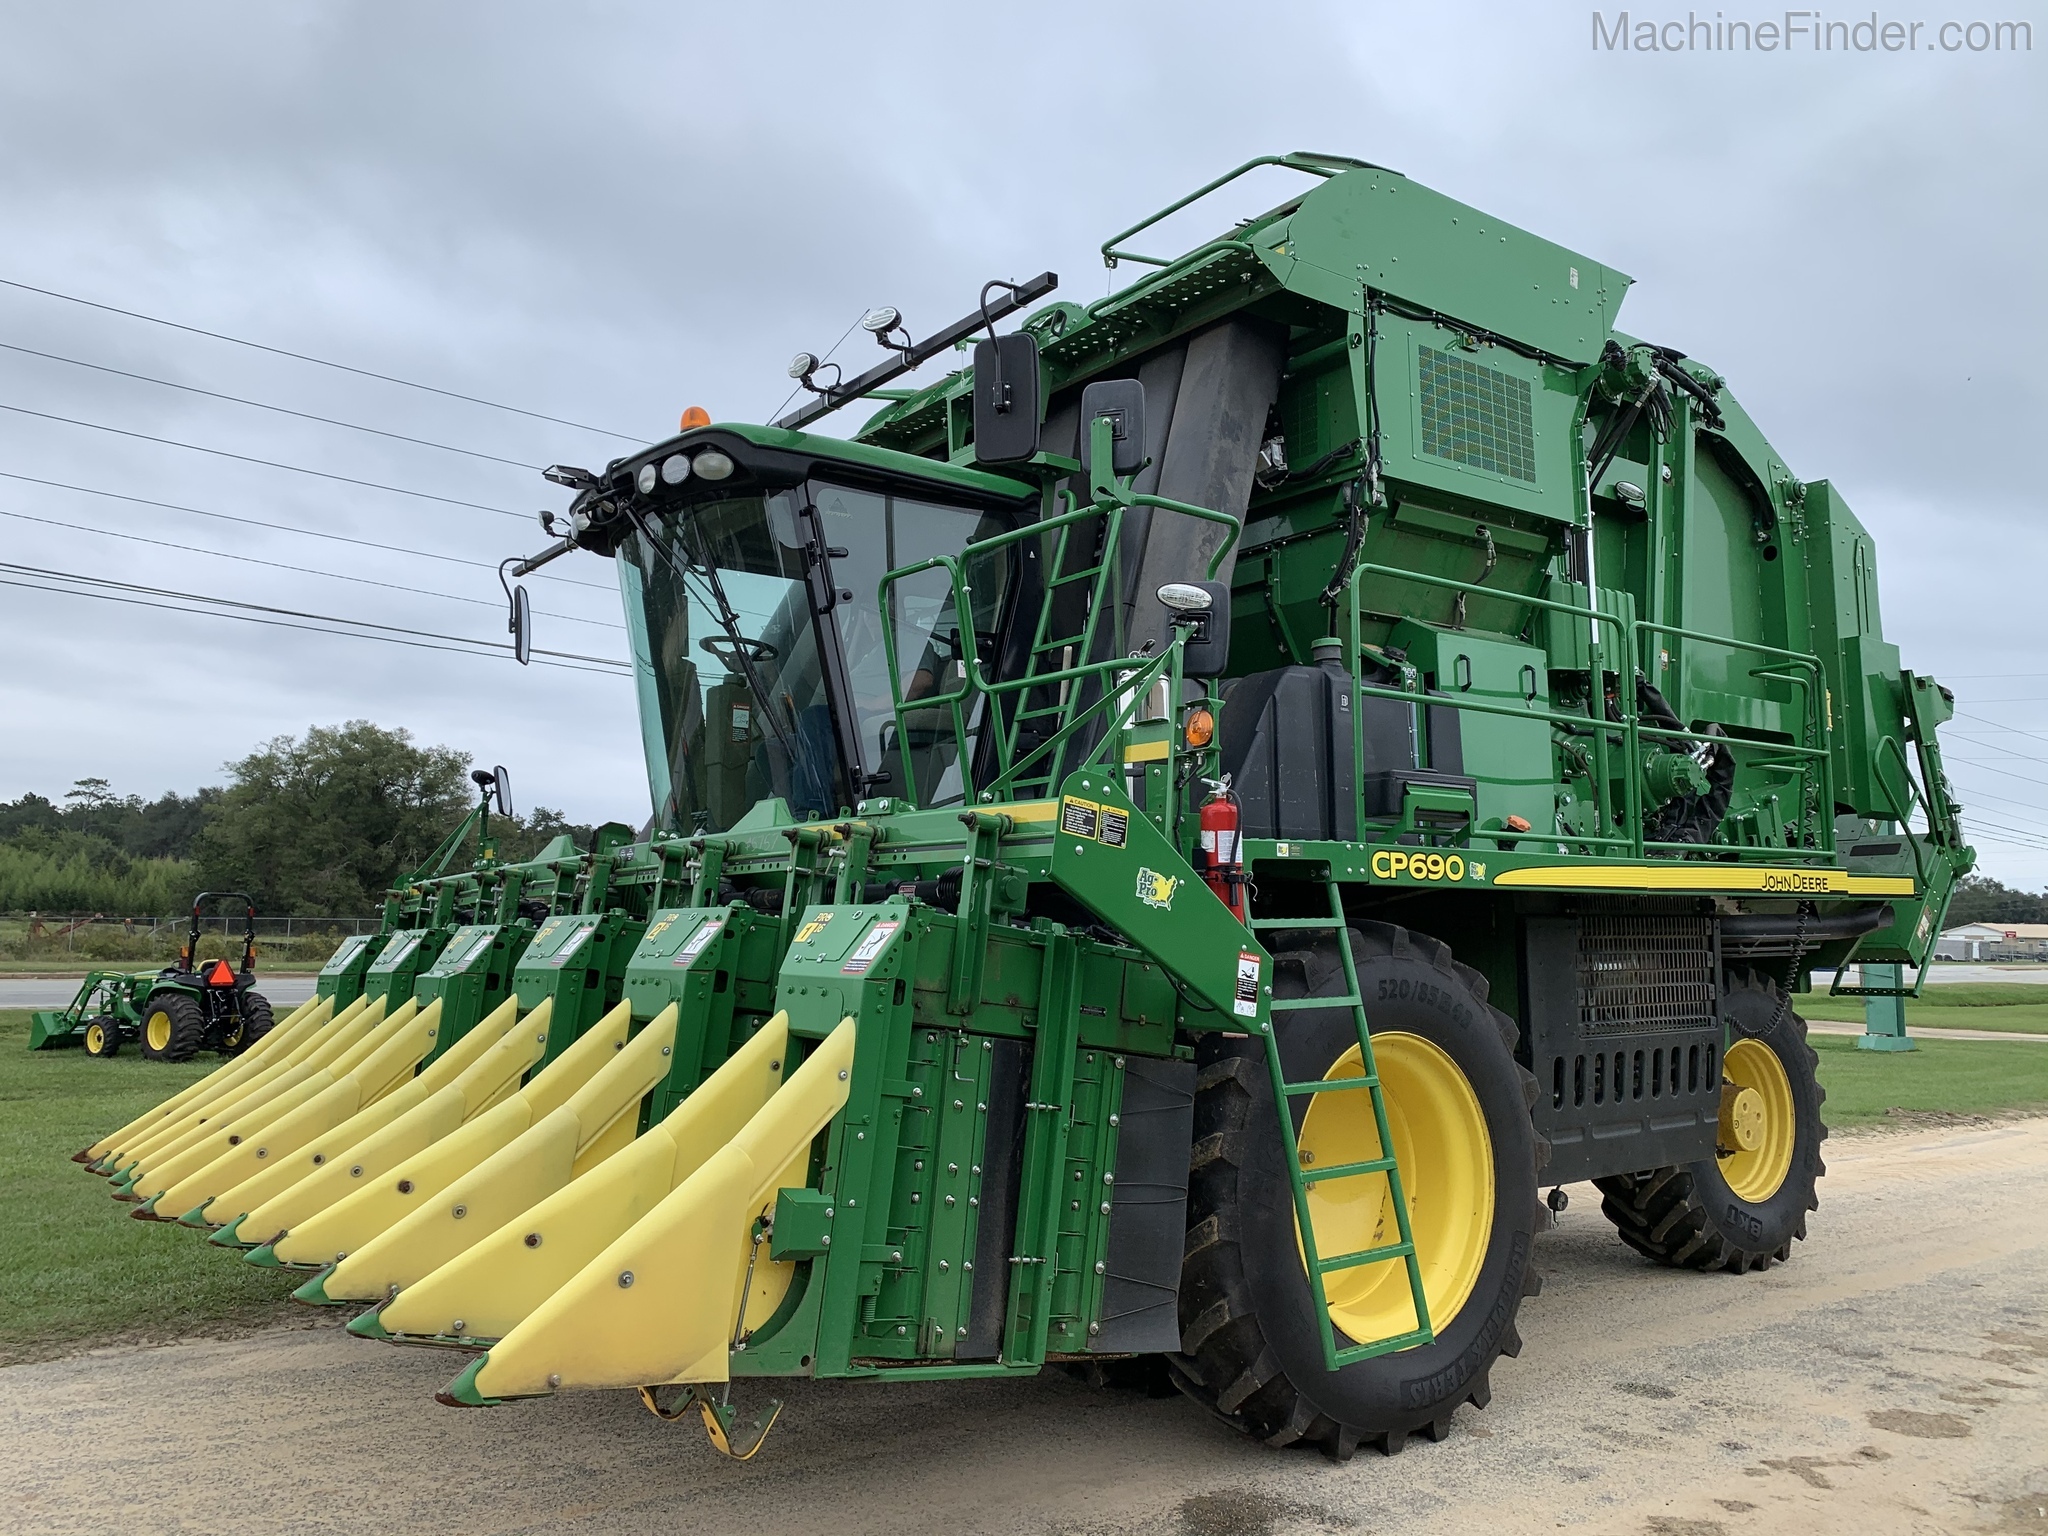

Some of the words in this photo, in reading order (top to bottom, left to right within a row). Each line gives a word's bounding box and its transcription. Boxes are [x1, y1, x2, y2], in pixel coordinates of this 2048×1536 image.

[1074, 799, 1094, 809] CAUTION
[1371, 850, 1465, 882] CP690
[1138, 882, 1157, 897] Pro
[1761, 872, 1792, 889] JOHN
[1793, 873, 1829, 890] DEERE
[1726, 1206, 1762, 1240] BKT
